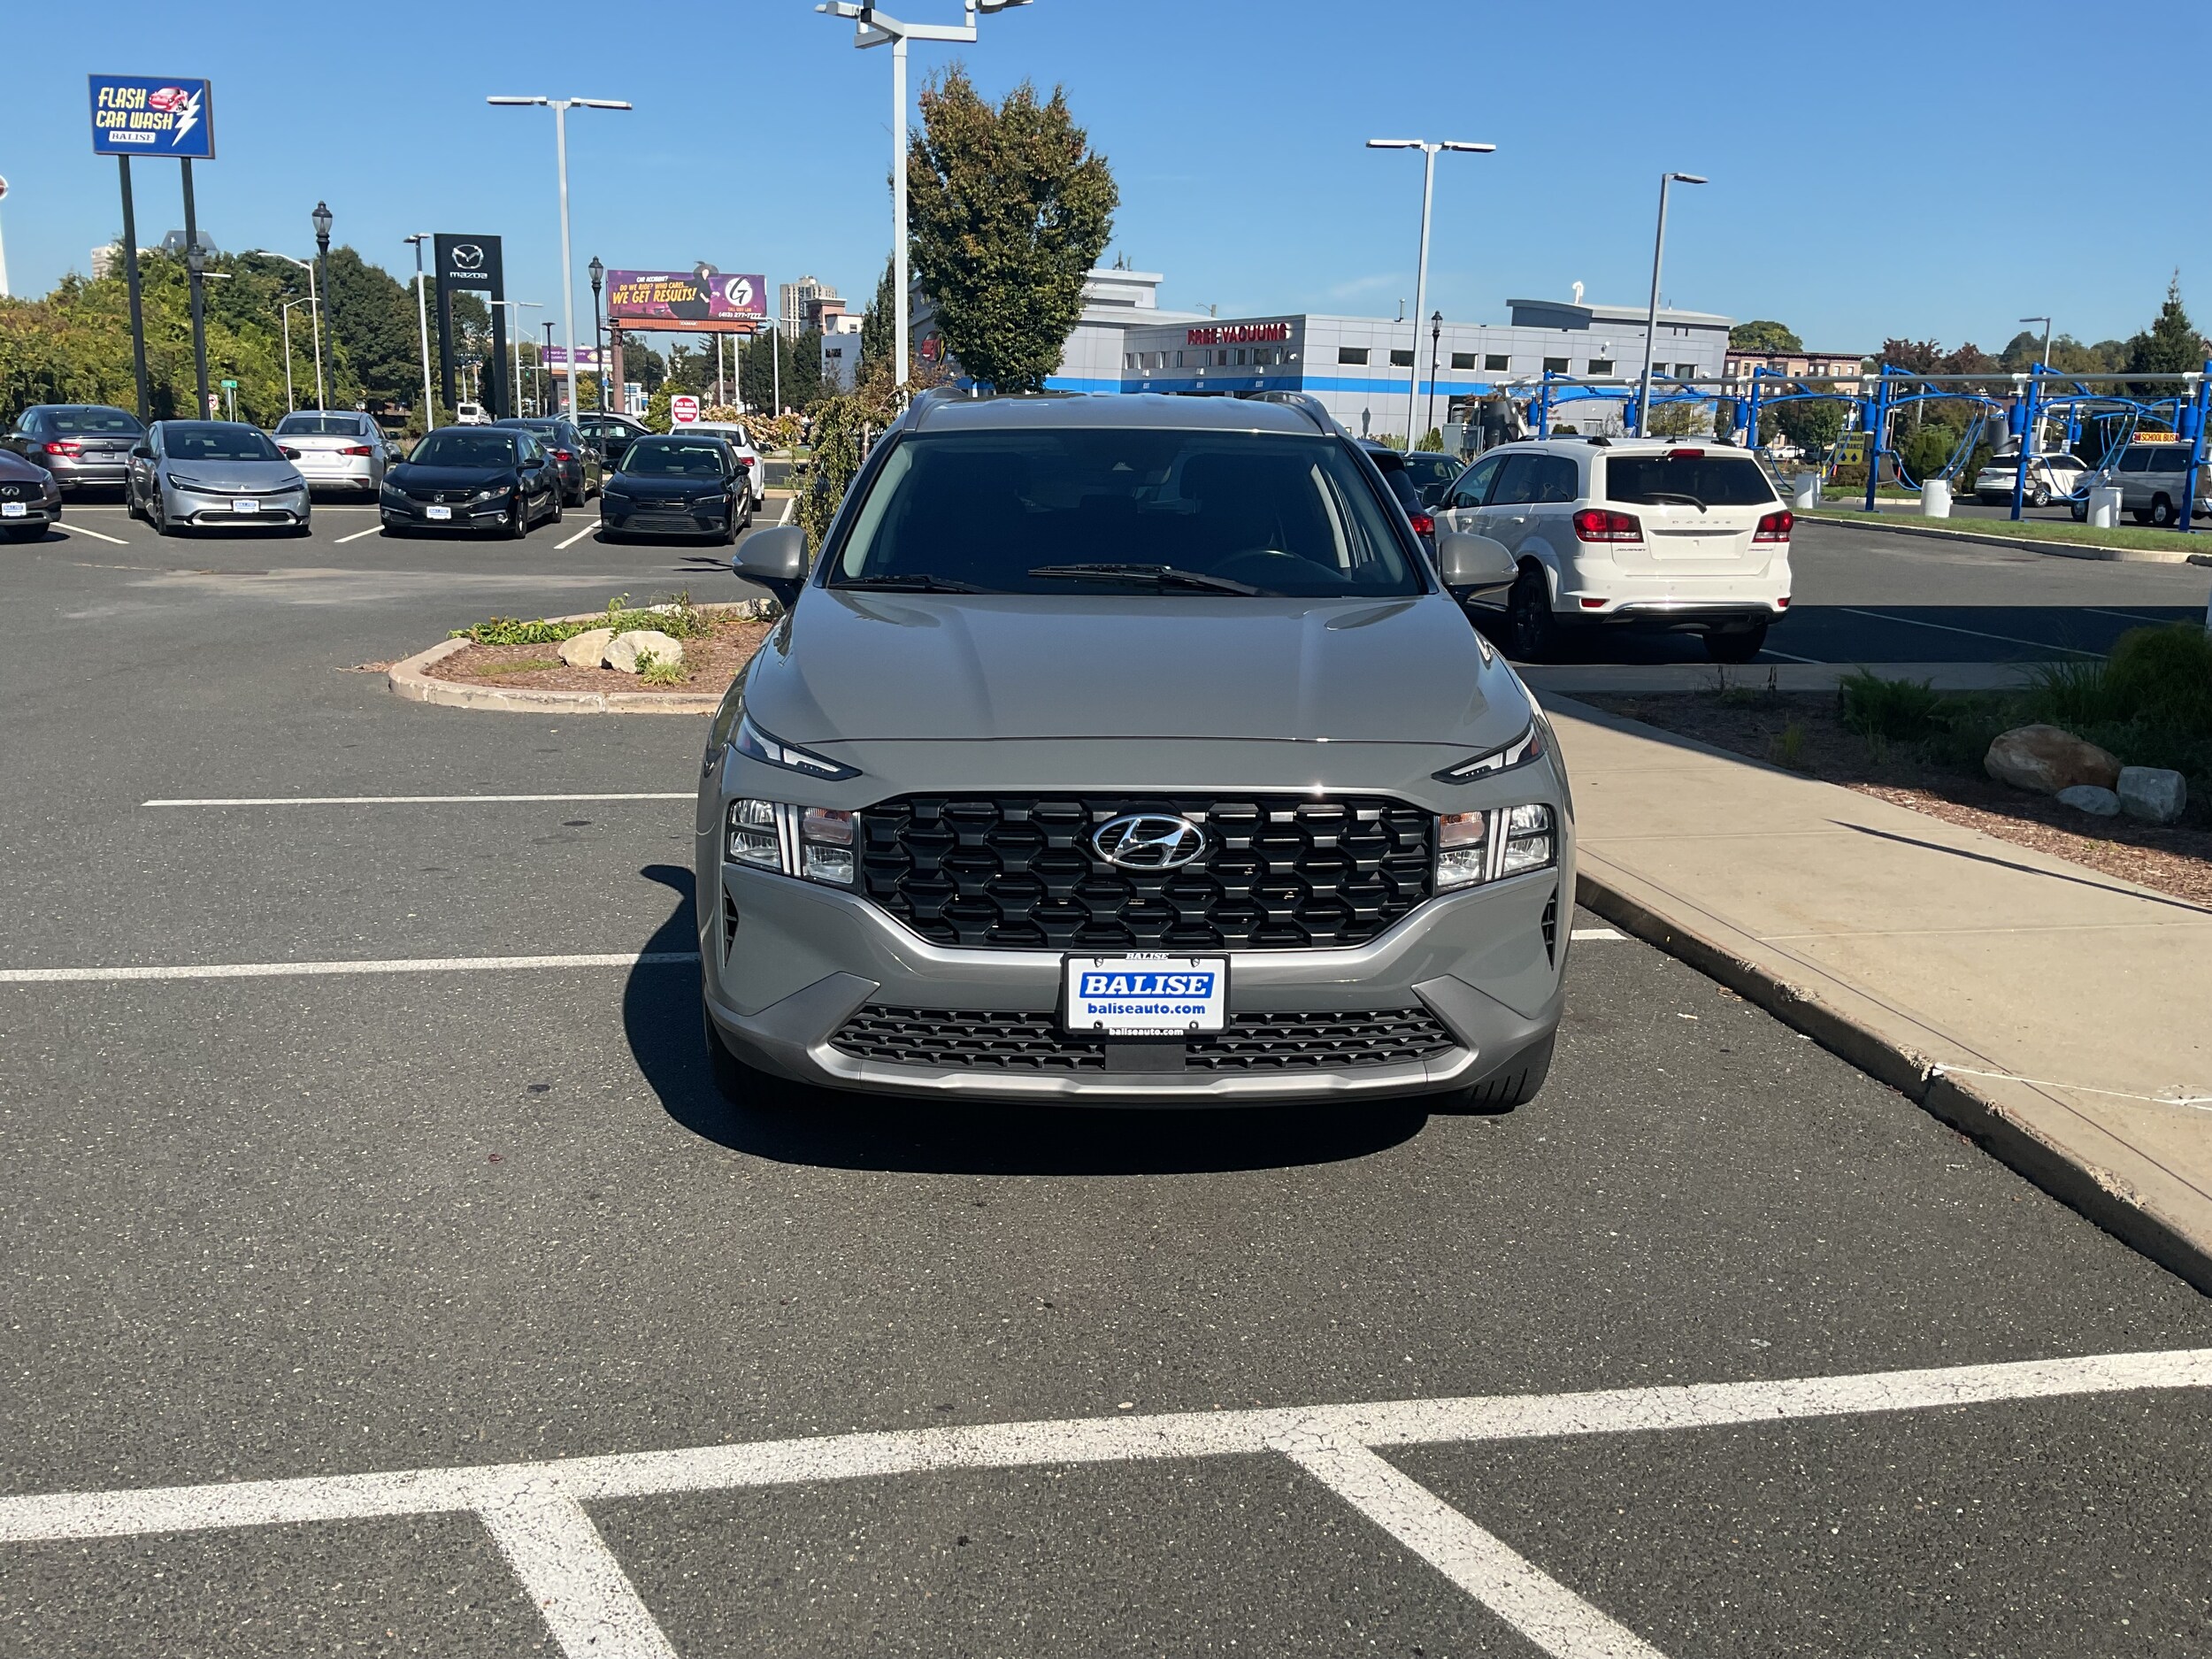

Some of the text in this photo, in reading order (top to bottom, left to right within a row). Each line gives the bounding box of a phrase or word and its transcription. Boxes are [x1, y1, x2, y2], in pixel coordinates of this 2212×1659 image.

[98, 87, 147, 110] FLASH
[96, 111, 174, 130] CAR WASH
[111, 132, 154, 142] BALISE
[612, 288, 697, 304] WE GET RESULTS!
[1187, 323, 1290, 345] FREE VACUUMS
[2141, 433, 2162, 442] SCHOOL
[1085, 975, 1210, 995] BALISE
[1087, 1002, 1206, 1014] baliseauto.com
[1109, 1027, 1184, 1036] baliseauto.com
